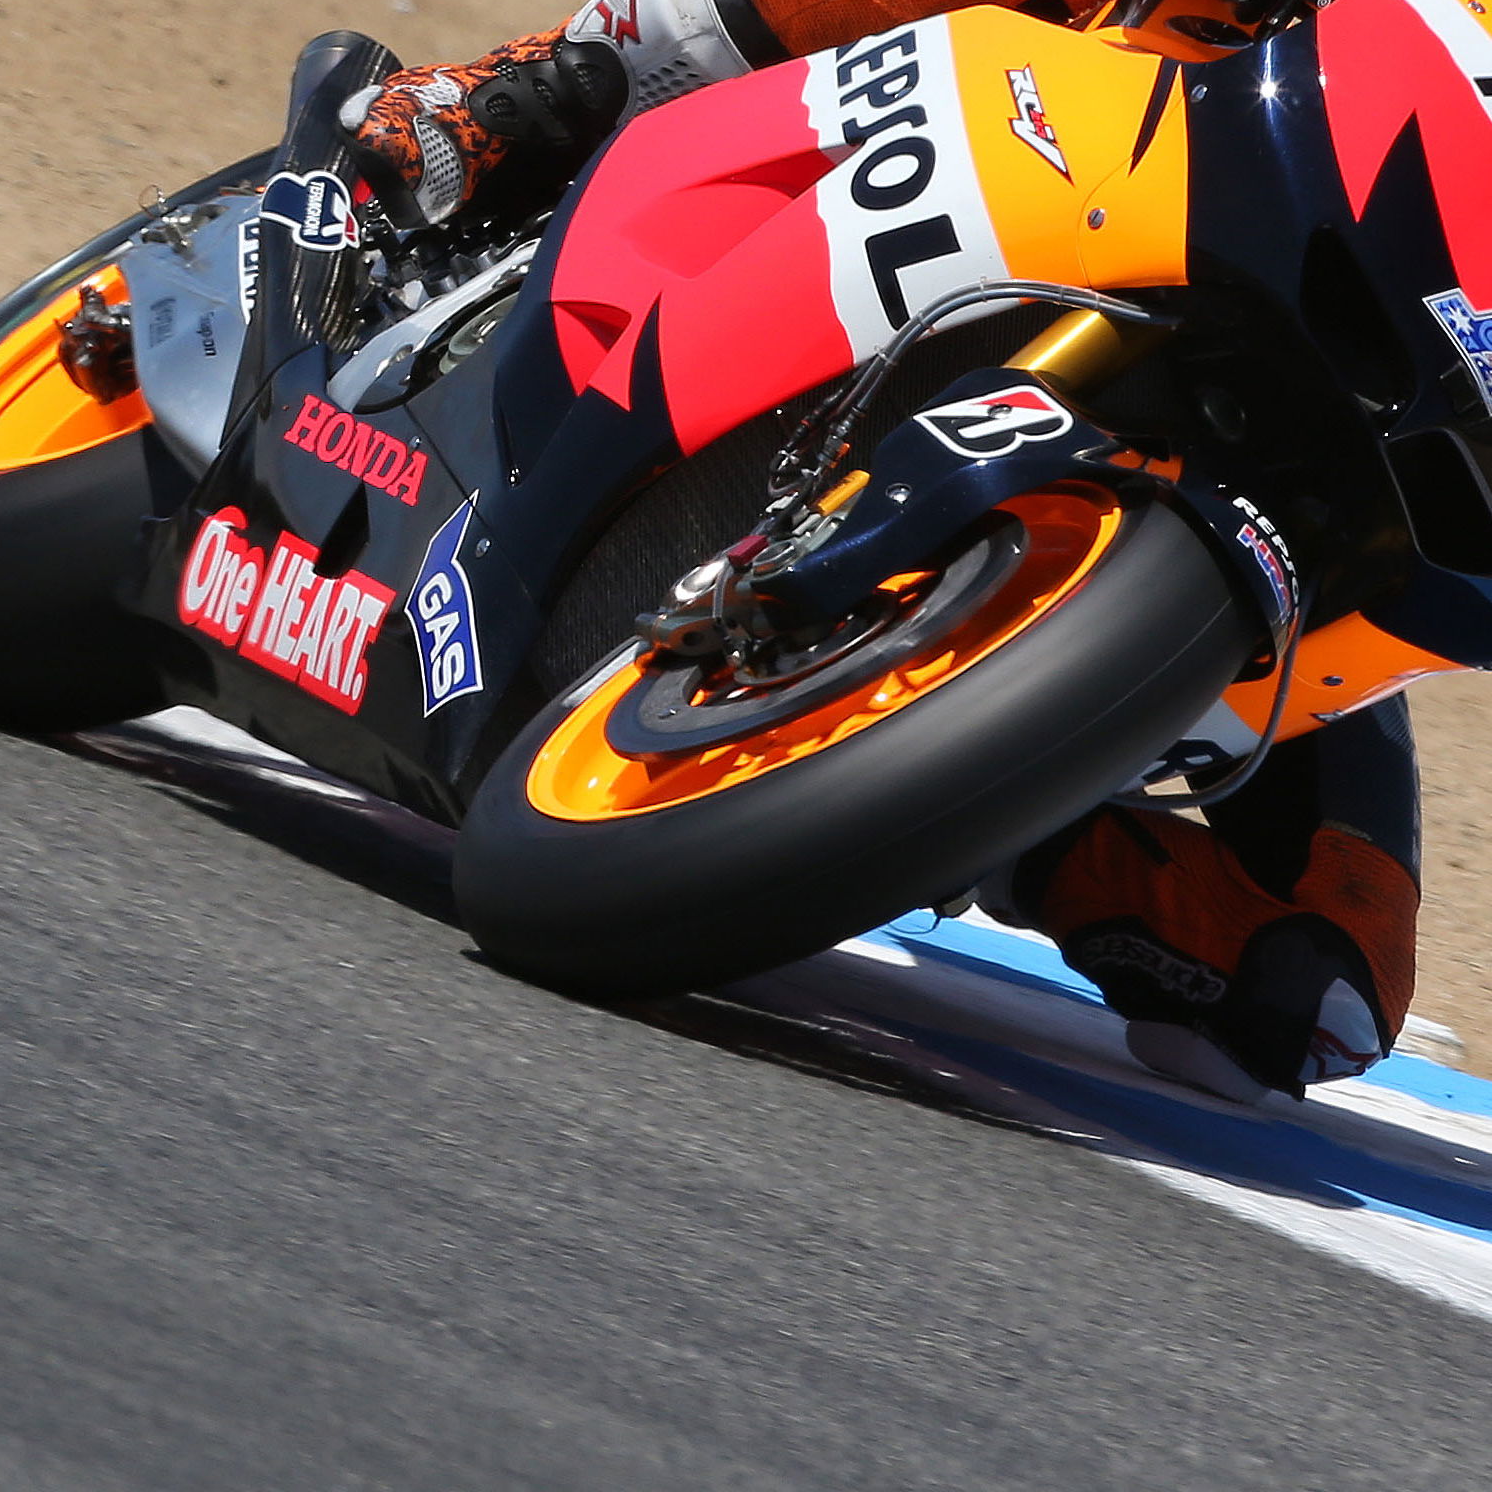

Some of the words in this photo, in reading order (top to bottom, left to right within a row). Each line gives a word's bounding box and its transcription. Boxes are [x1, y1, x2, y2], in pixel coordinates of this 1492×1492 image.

[283, 394, 428, 506] HONDA
[185, 518, 259, 633] One
[417, 571, 466, 700] GAS
